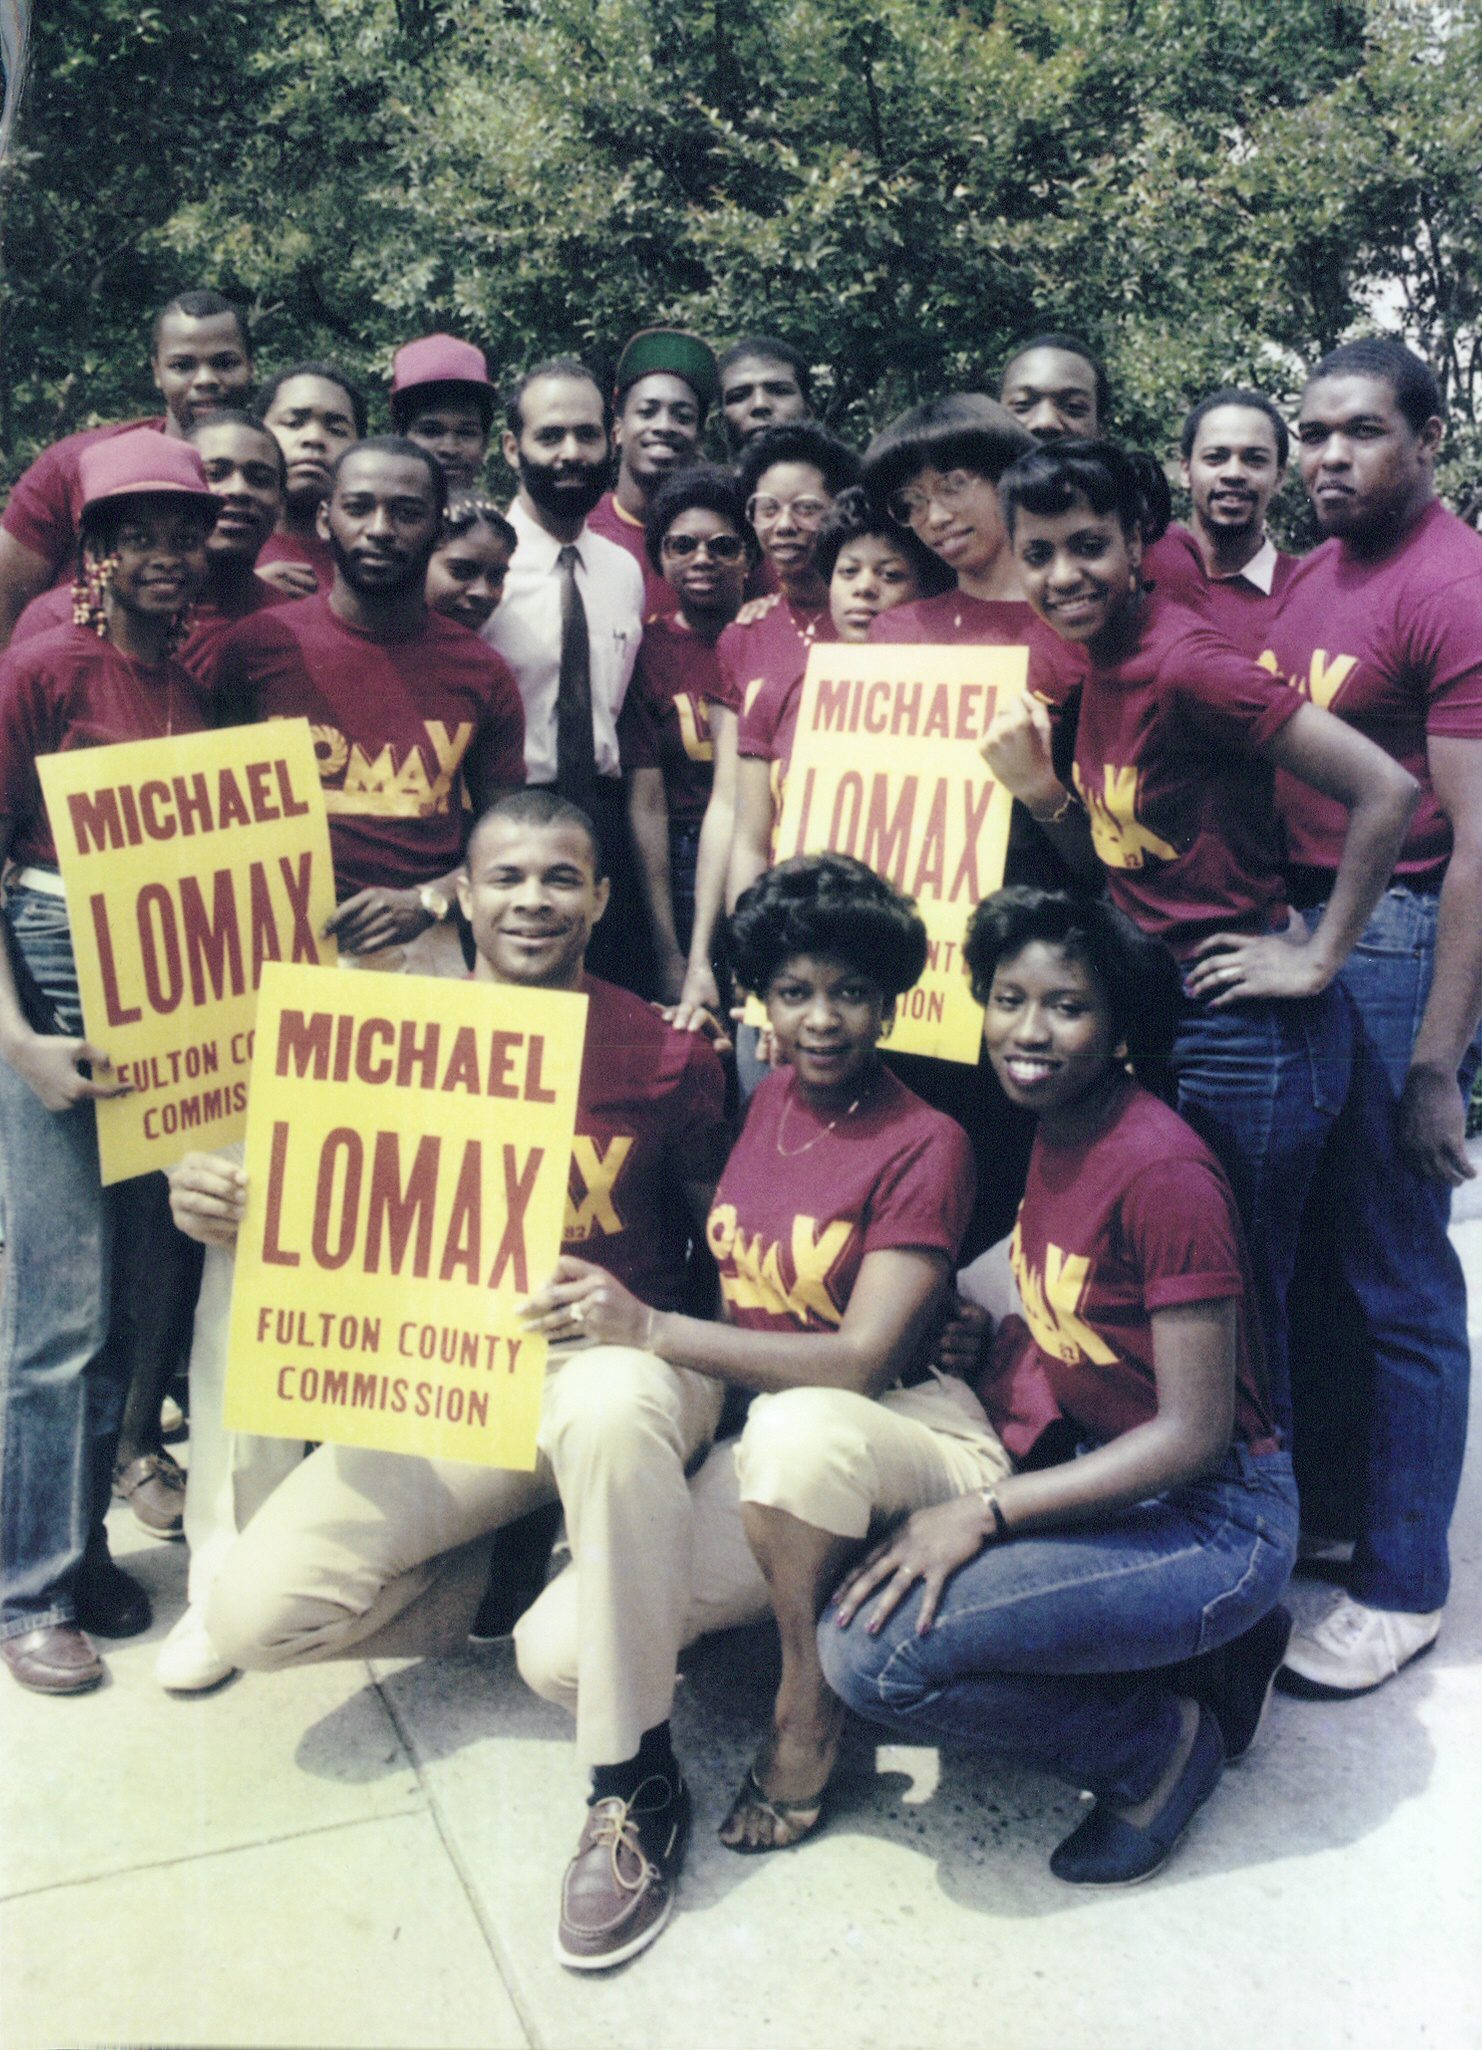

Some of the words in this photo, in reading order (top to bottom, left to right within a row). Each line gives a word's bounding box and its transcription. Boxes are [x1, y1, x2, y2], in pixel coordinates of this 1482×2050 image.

[66, 758, 310, 856] MICHAEL
[90, 851, 321, 1028] LOMAX
[116, 1040, 219, 1099] FULTON
[275, 1008, 557, 1105] MICHAEL
[143, 1081, 247, 1140] COMMIS
[261, 1120, 546, 1296] LOMAX
[256, 1307, 382, 1354] FULTON
[398, 1321, 523, 1375] COUNTY
[277, 1365, 489, 1428] COMMISSION
